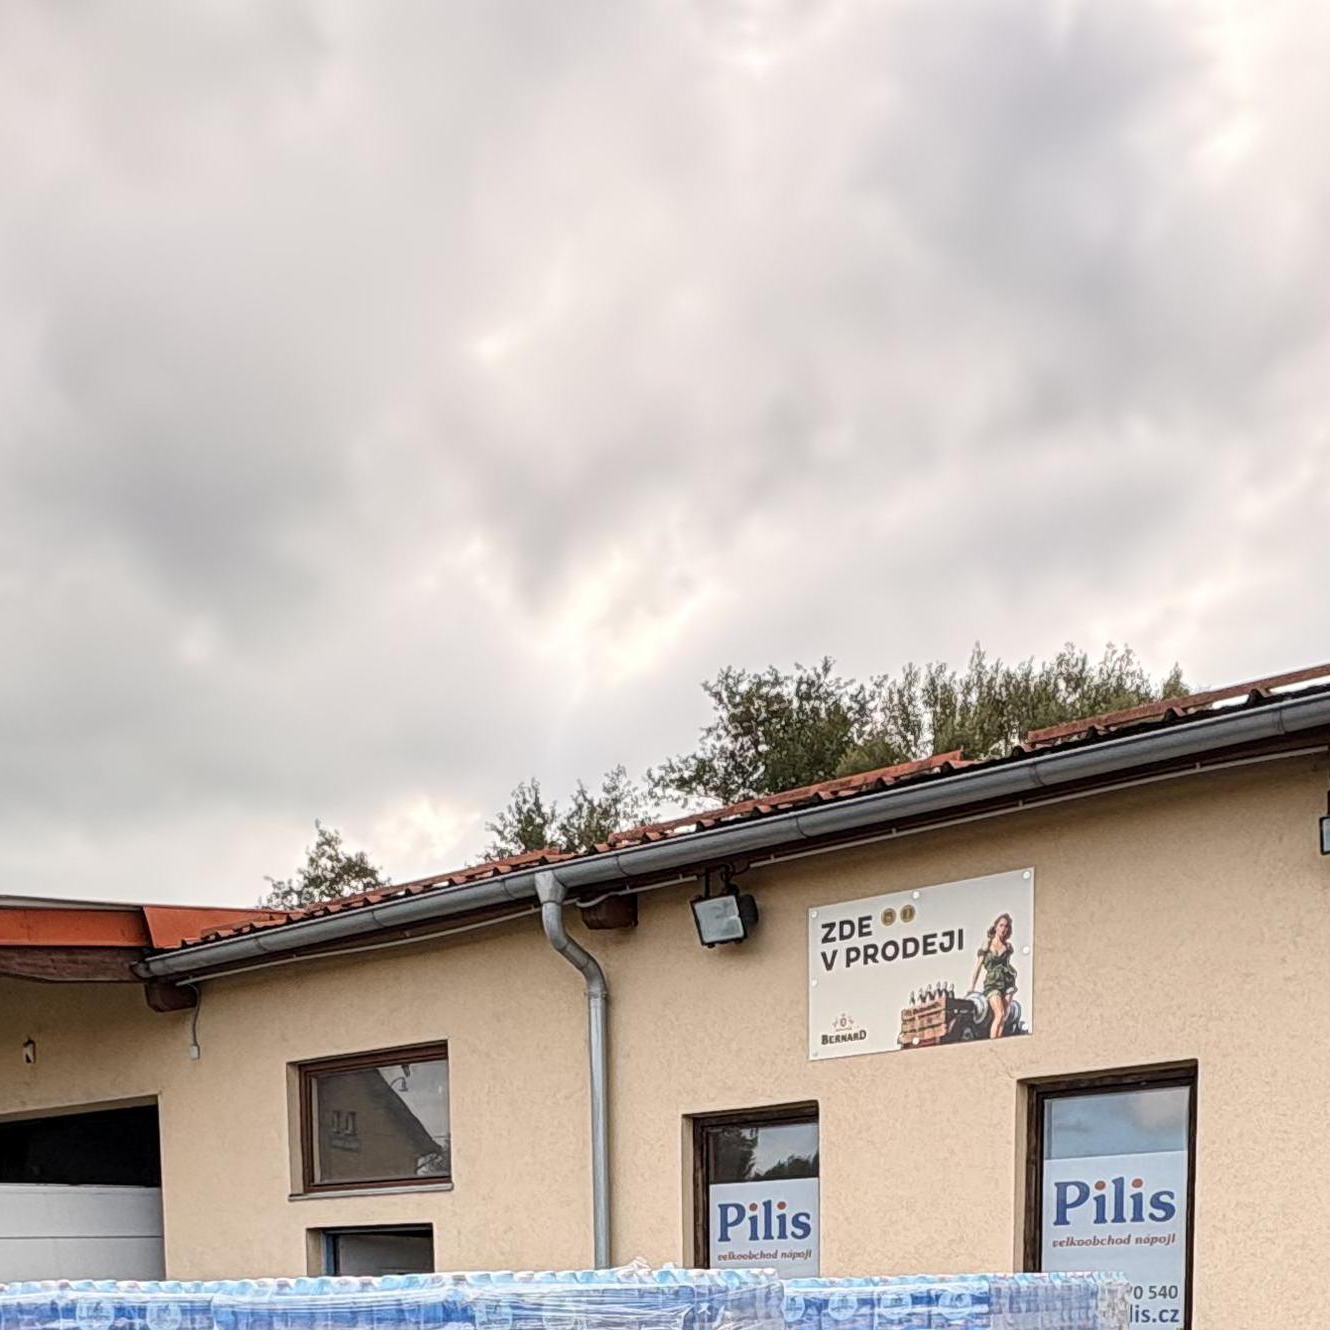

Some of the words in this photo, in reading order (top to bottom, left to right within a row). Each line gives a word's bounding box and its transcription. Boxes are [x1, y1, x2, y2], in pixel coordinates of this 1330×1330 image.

[821, 915, 873, 944] ZDE
[821, 949, 838, 972] V
[845, 928, 964, 968] PRODEJI
[821, 1029, 867, 1045] BERNARD
[1053, 1176, 1176, 1226] Pilis
[717, 1199, 811, 1242] Pilis
[1052, 1232, 1131, 1248] velkoobchod
[717, 1250, 778, 1261] velkoobchod
[1148, 1284, 1178, 1300] 540
[1130, 1304, 1180, 1324] lis.cz
